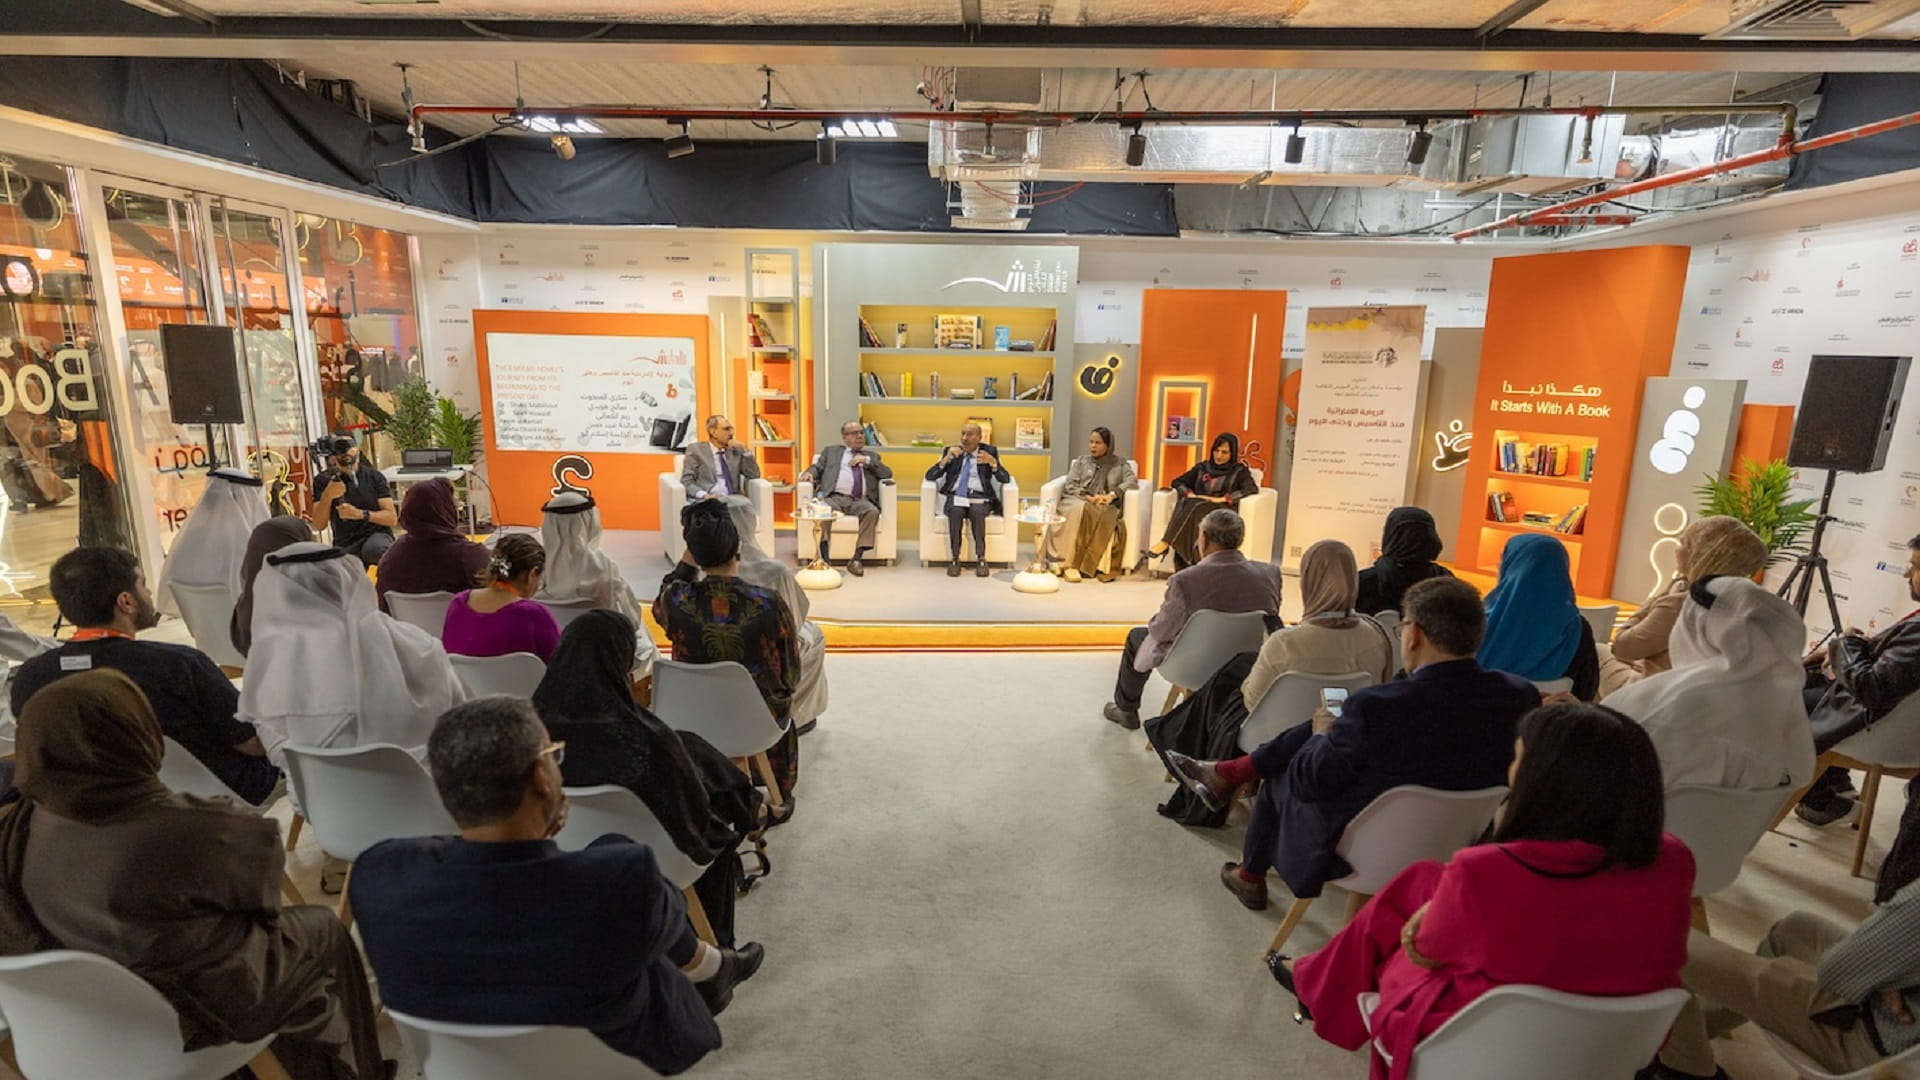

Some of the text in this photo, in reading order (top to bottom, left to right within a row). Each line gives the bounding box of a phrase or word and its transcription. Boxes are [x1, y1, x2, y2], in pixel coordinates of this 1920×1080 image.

[1490, 399, 1610, 417] It Starts With A Book
